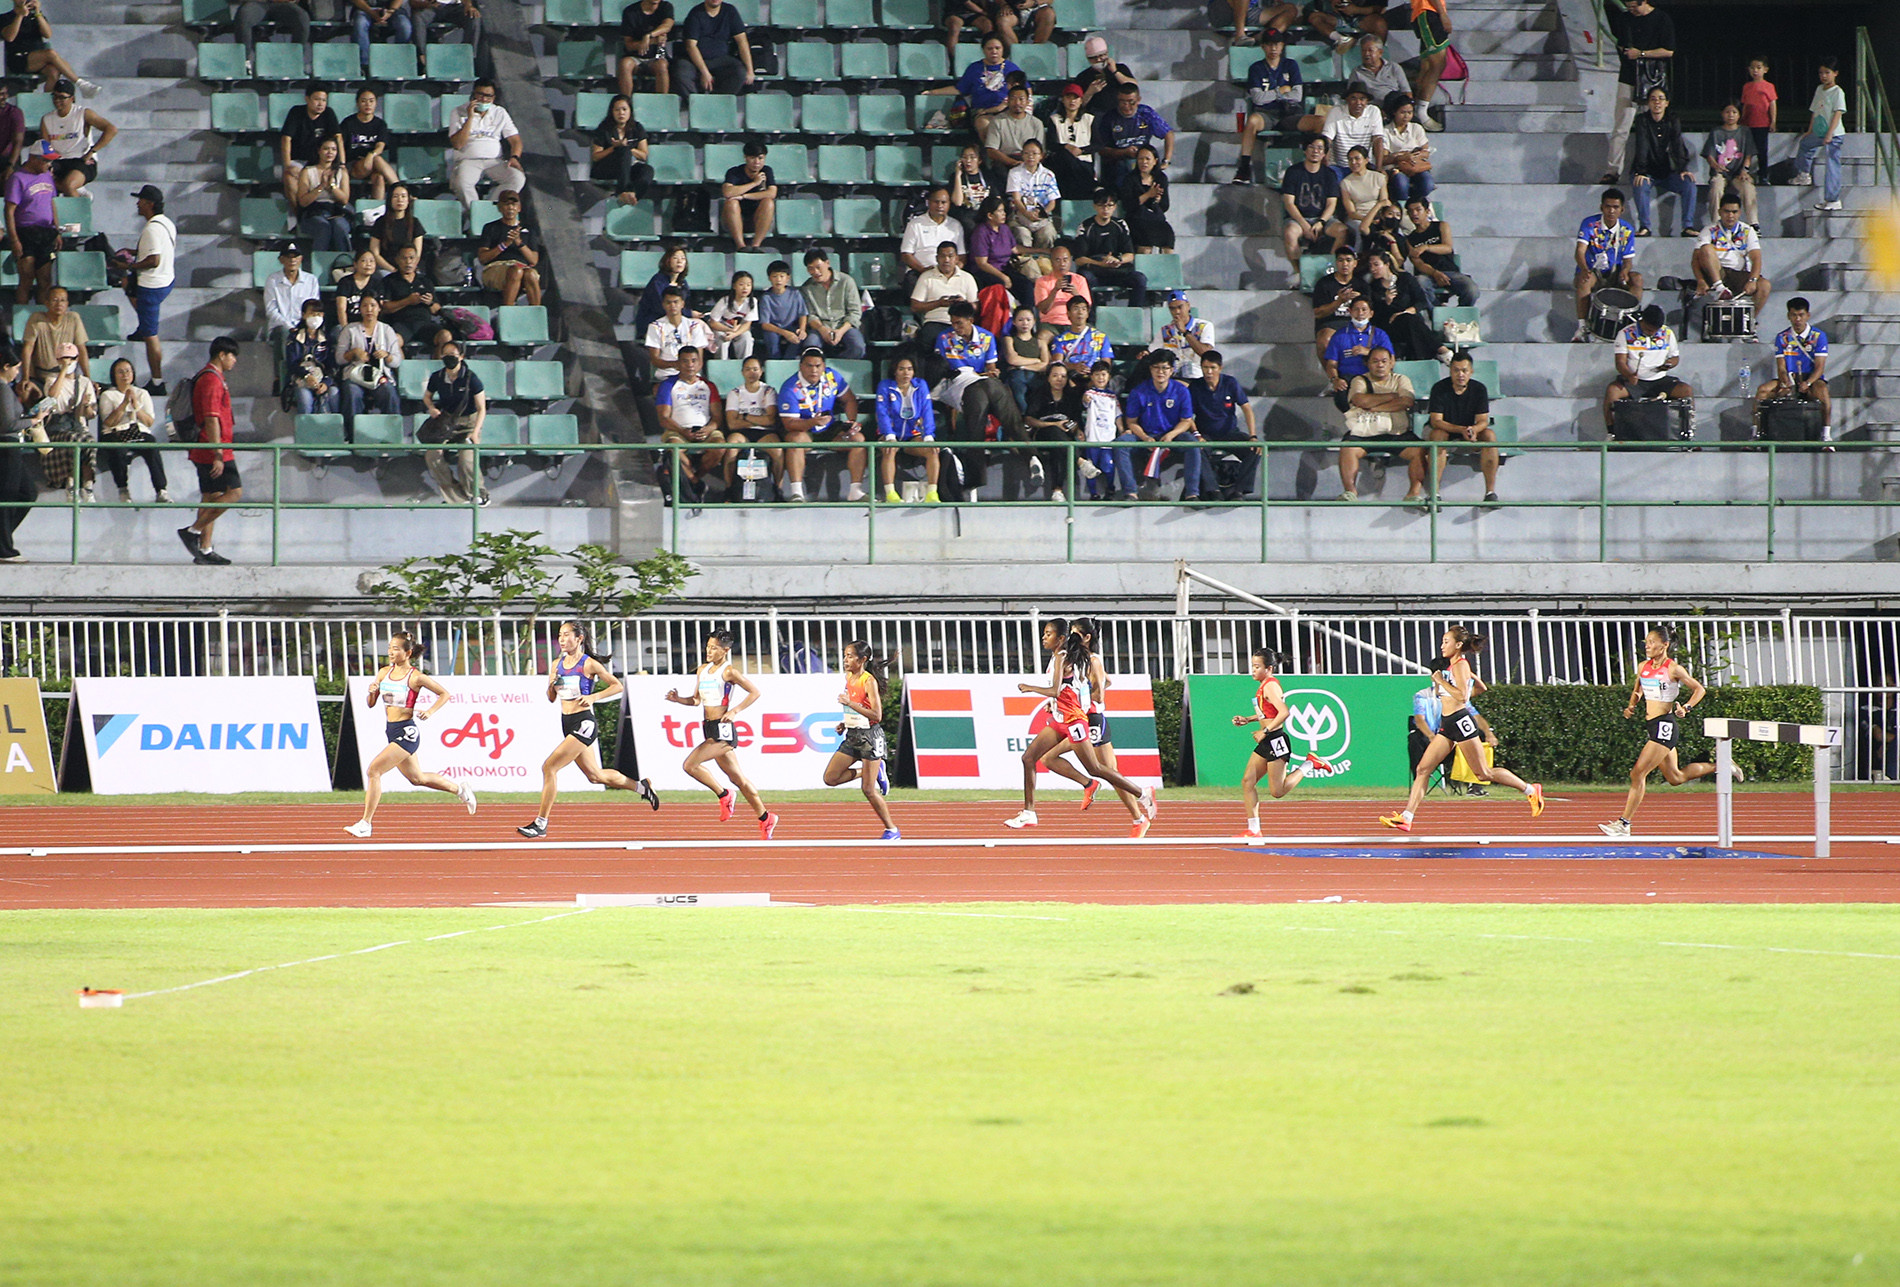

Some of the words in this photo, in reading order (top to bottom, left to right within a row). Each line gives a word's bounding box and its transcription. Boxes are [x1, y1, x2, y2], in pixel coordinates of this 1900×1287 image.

[415, 694, 432, 704] at
[471, 693, 498, 704] Live
[661, 715, 755, 748] tre
[761, 712, 845, 754] 5G
[1073, 726, 1082, 739] 1
[1461, 720, 1472, 733] 6
[140, 723, 308, 751] DAIKIN
[408, 727, 417, 740] 2
[441, 713, 515, 759] Aj
[1828, 730, 1838, 743] 7
[1007, 738, 1033, 752] ELE
[1275, 739, 1286, 753] 4
[438, 766, 527, 779] AJINOMOTO
[664, 895, 698, 904] UCS
